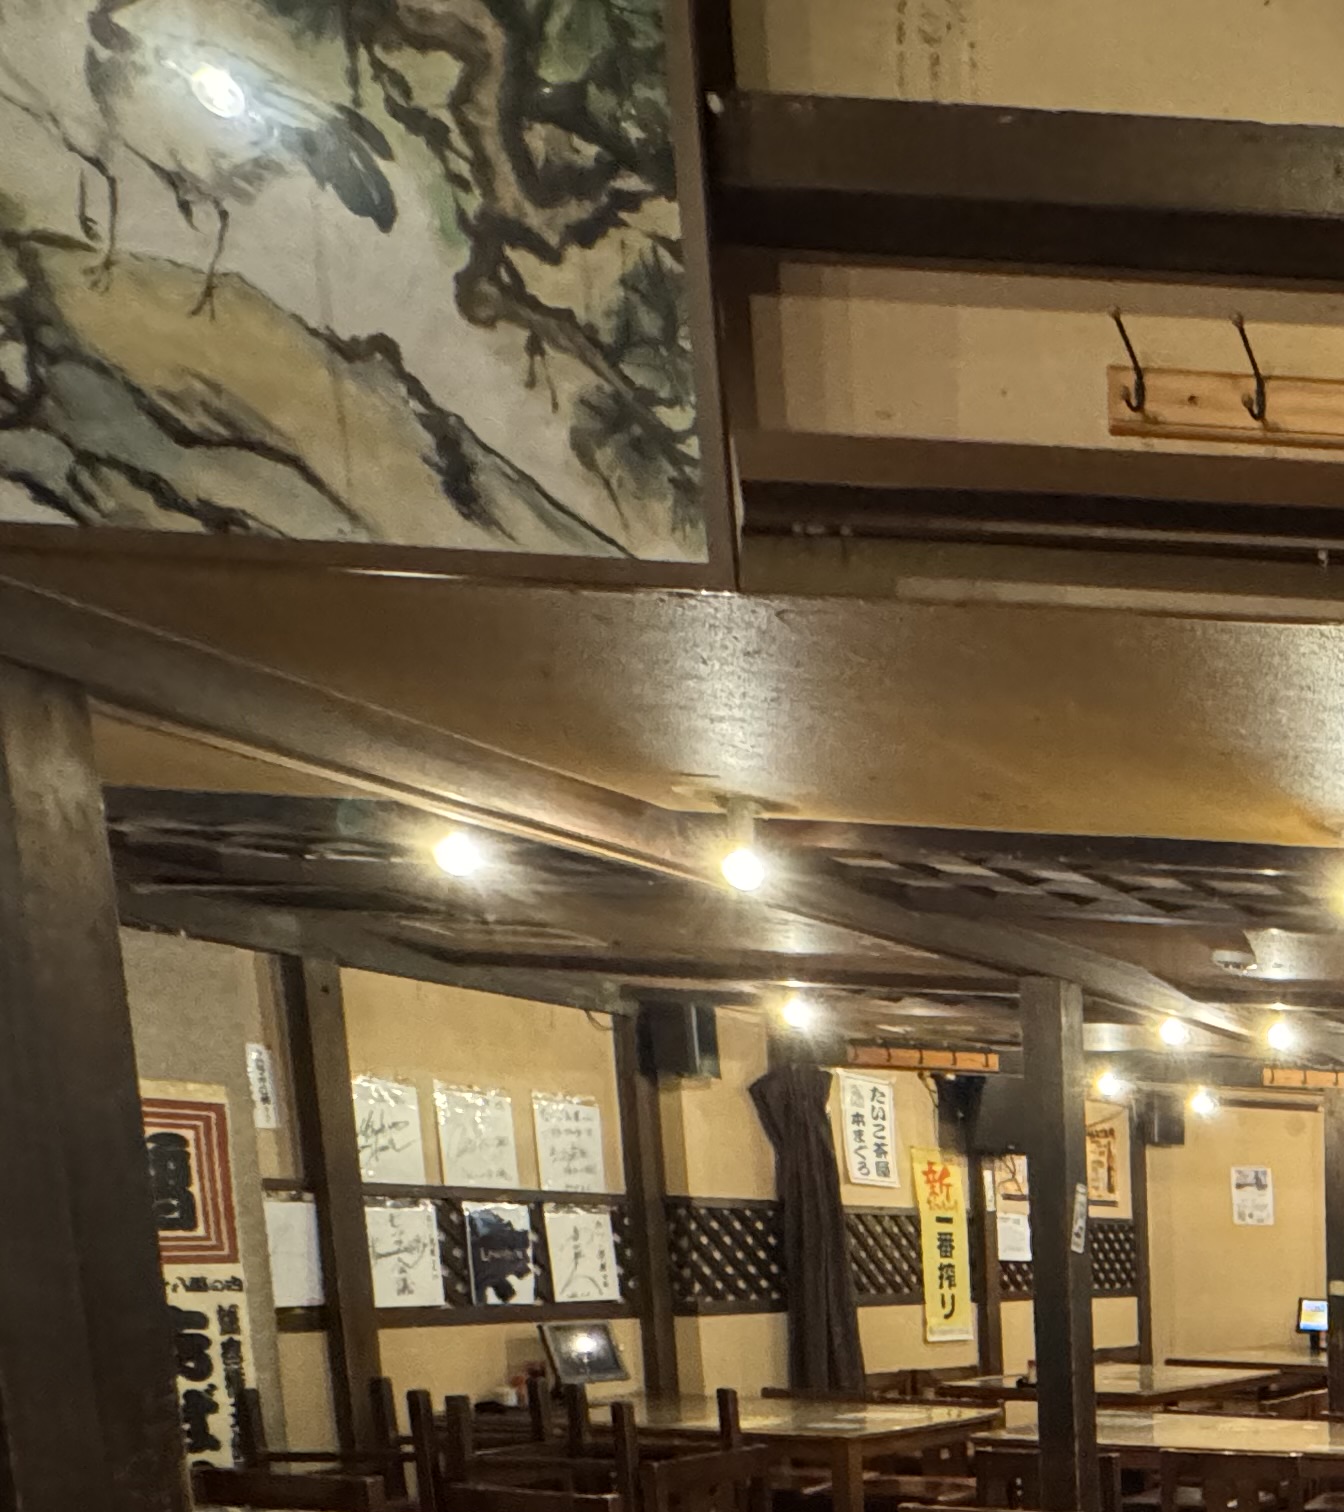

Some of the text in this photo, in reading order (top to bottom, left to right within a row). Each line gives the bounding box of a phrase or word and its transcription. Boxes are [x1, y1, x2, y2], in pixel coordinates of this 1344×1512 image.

[851, 1112, 870, 1177] 本まぐろ
[935, 1216, 956, 1319] 一番搾り
